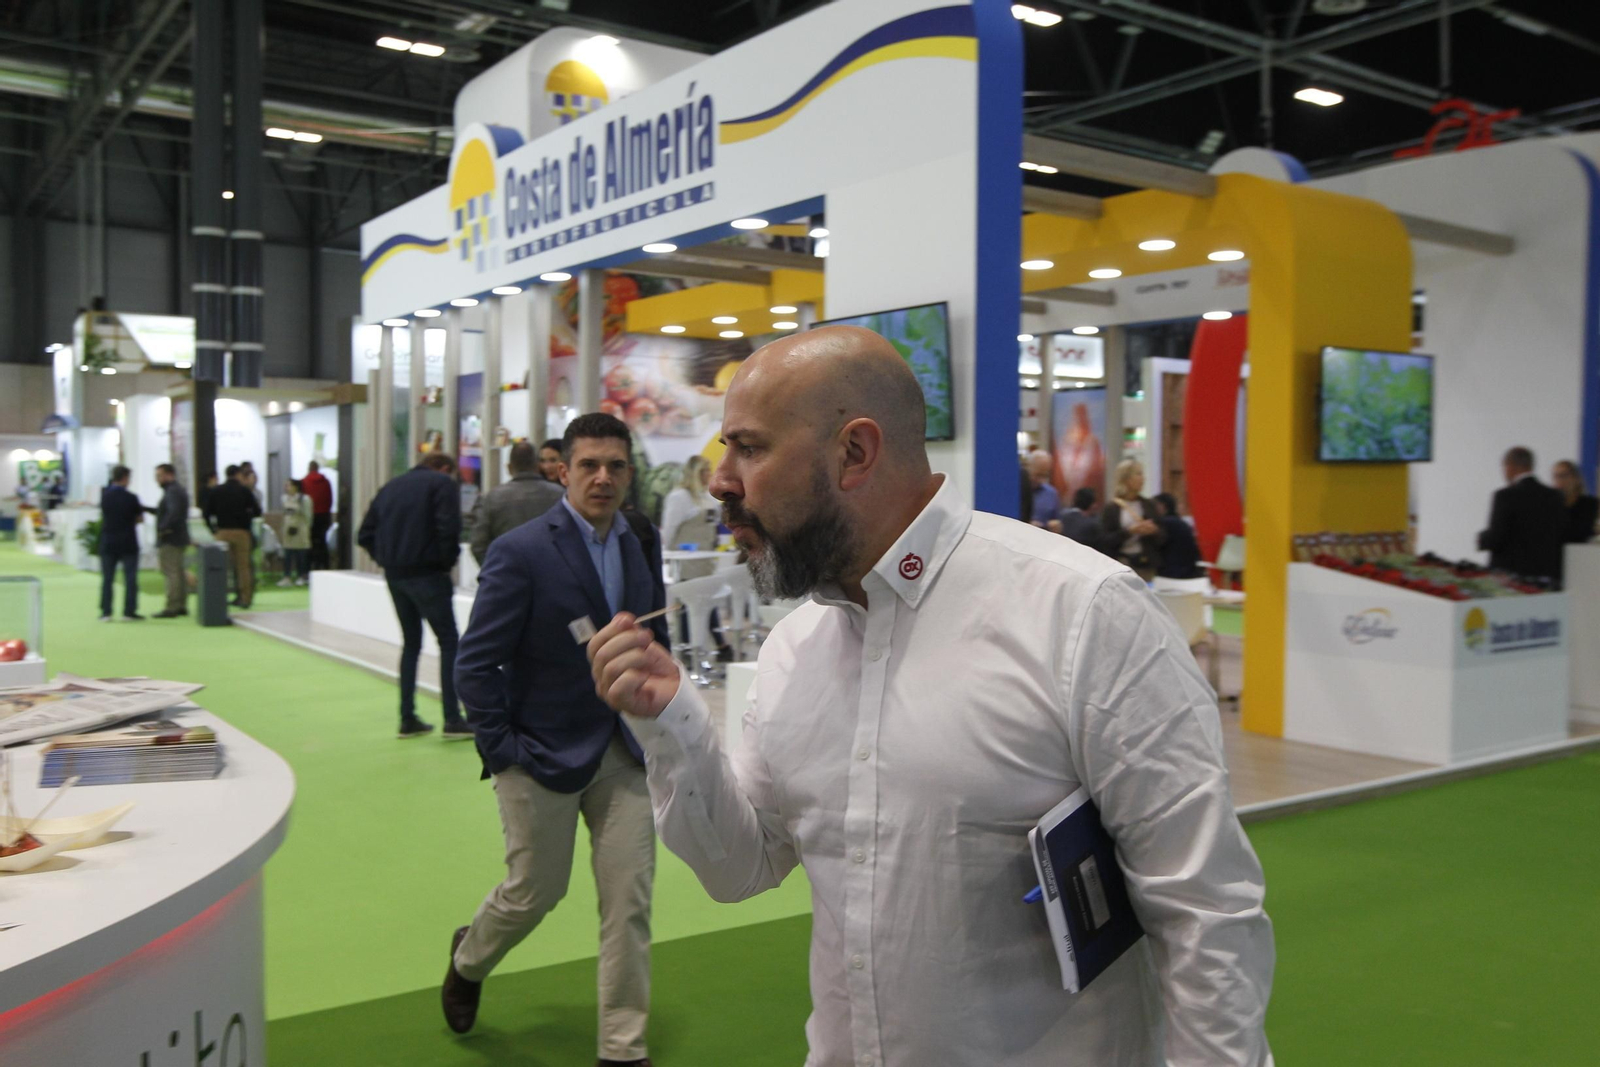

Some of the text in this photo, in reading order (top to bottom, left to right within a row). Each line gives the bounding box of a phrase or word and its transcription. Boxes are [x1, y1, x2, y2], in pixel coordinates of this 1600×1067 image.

[505, 80, 714, 239] Costa de Almería
[505, 181, 714, 264] HORTOFRUTICOLA
